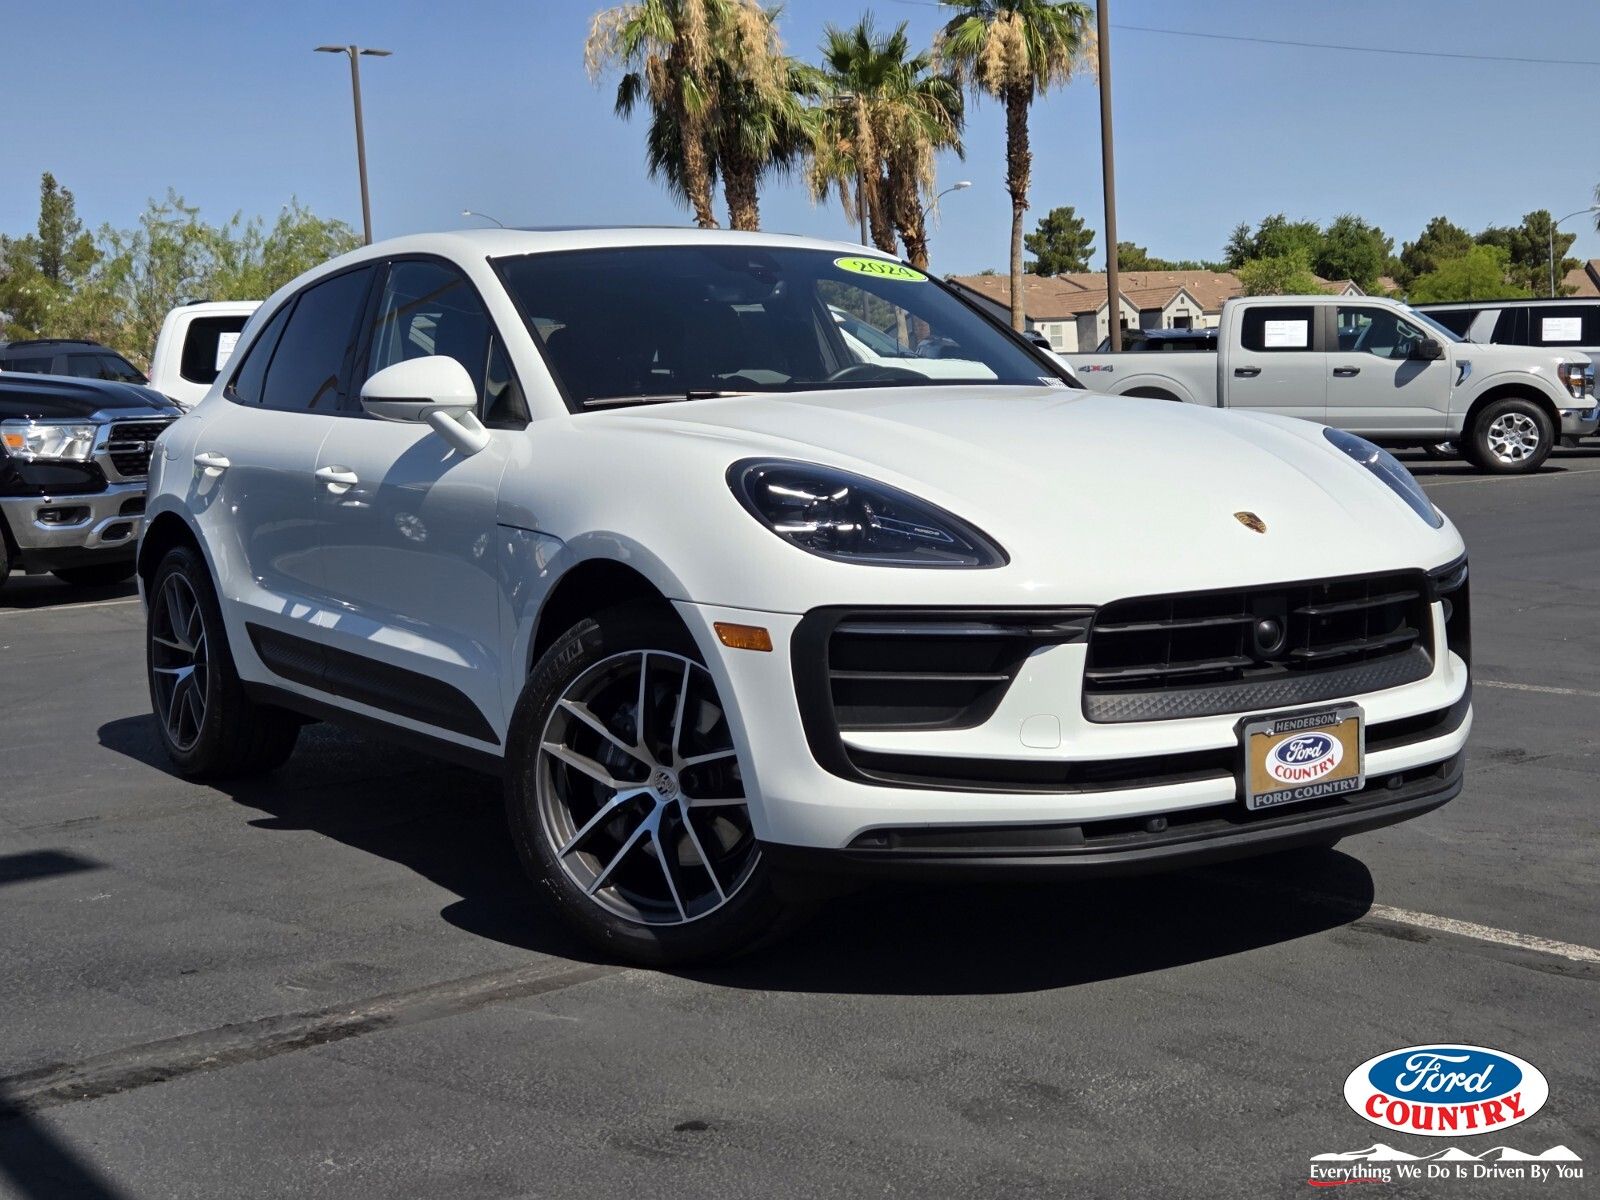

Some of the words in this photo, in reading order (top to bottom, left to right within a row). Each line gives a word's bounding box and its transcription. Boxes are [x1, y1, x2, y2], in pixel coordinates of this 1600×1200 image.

[1276, 714, 1335, 731] HENDERSON
[1286, 738, 1323, 762] Ford
[1275, 755, 1335, 780] COUNTRY
[1255, 791, 1292, 806] FORD
[1294, 778, 1357, 798] COUNTRY
